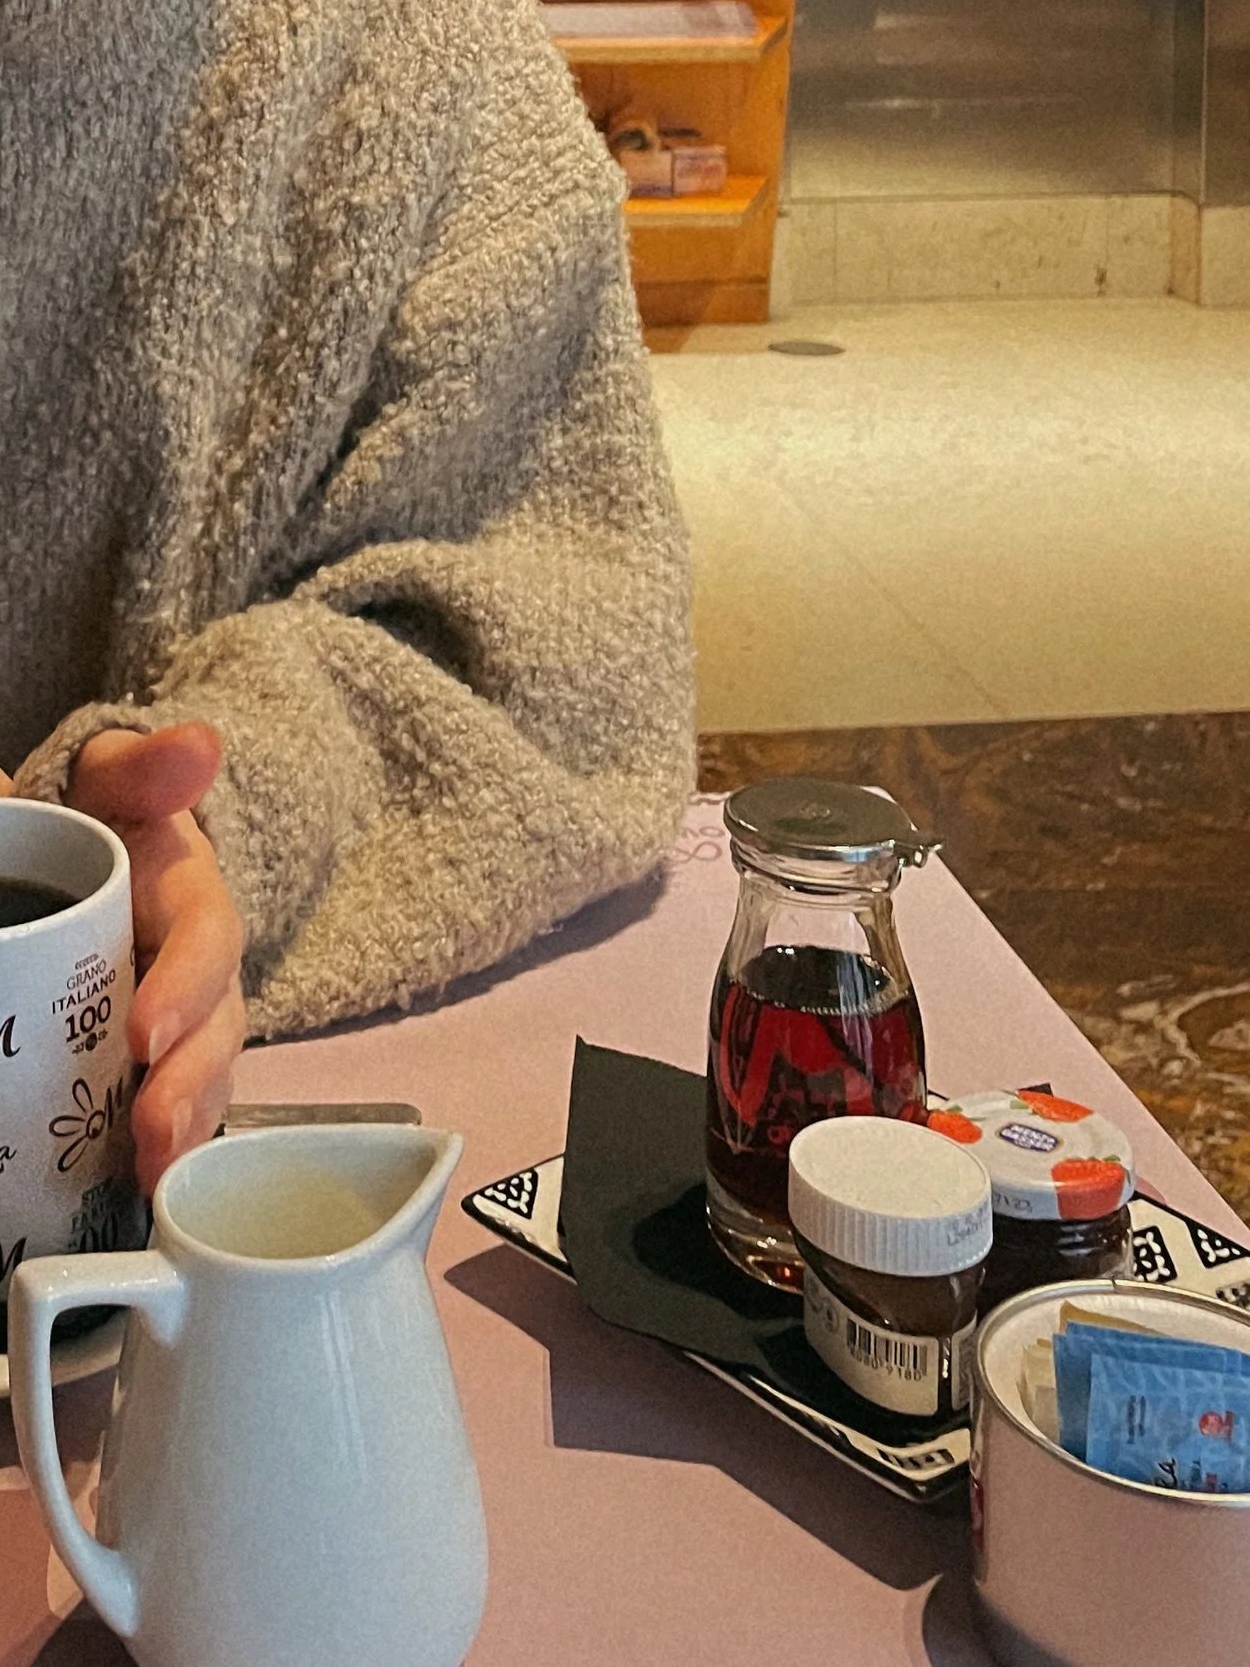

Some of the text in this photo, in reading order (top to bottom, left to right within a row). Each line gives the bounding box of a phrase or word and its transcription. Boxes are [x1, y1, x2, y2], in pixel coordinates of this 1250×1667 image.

[51, 969, 117, 1014] ITALIANO
[66, 959, 107, 990] GRANO
[65, 995, 112, 1043] 100
